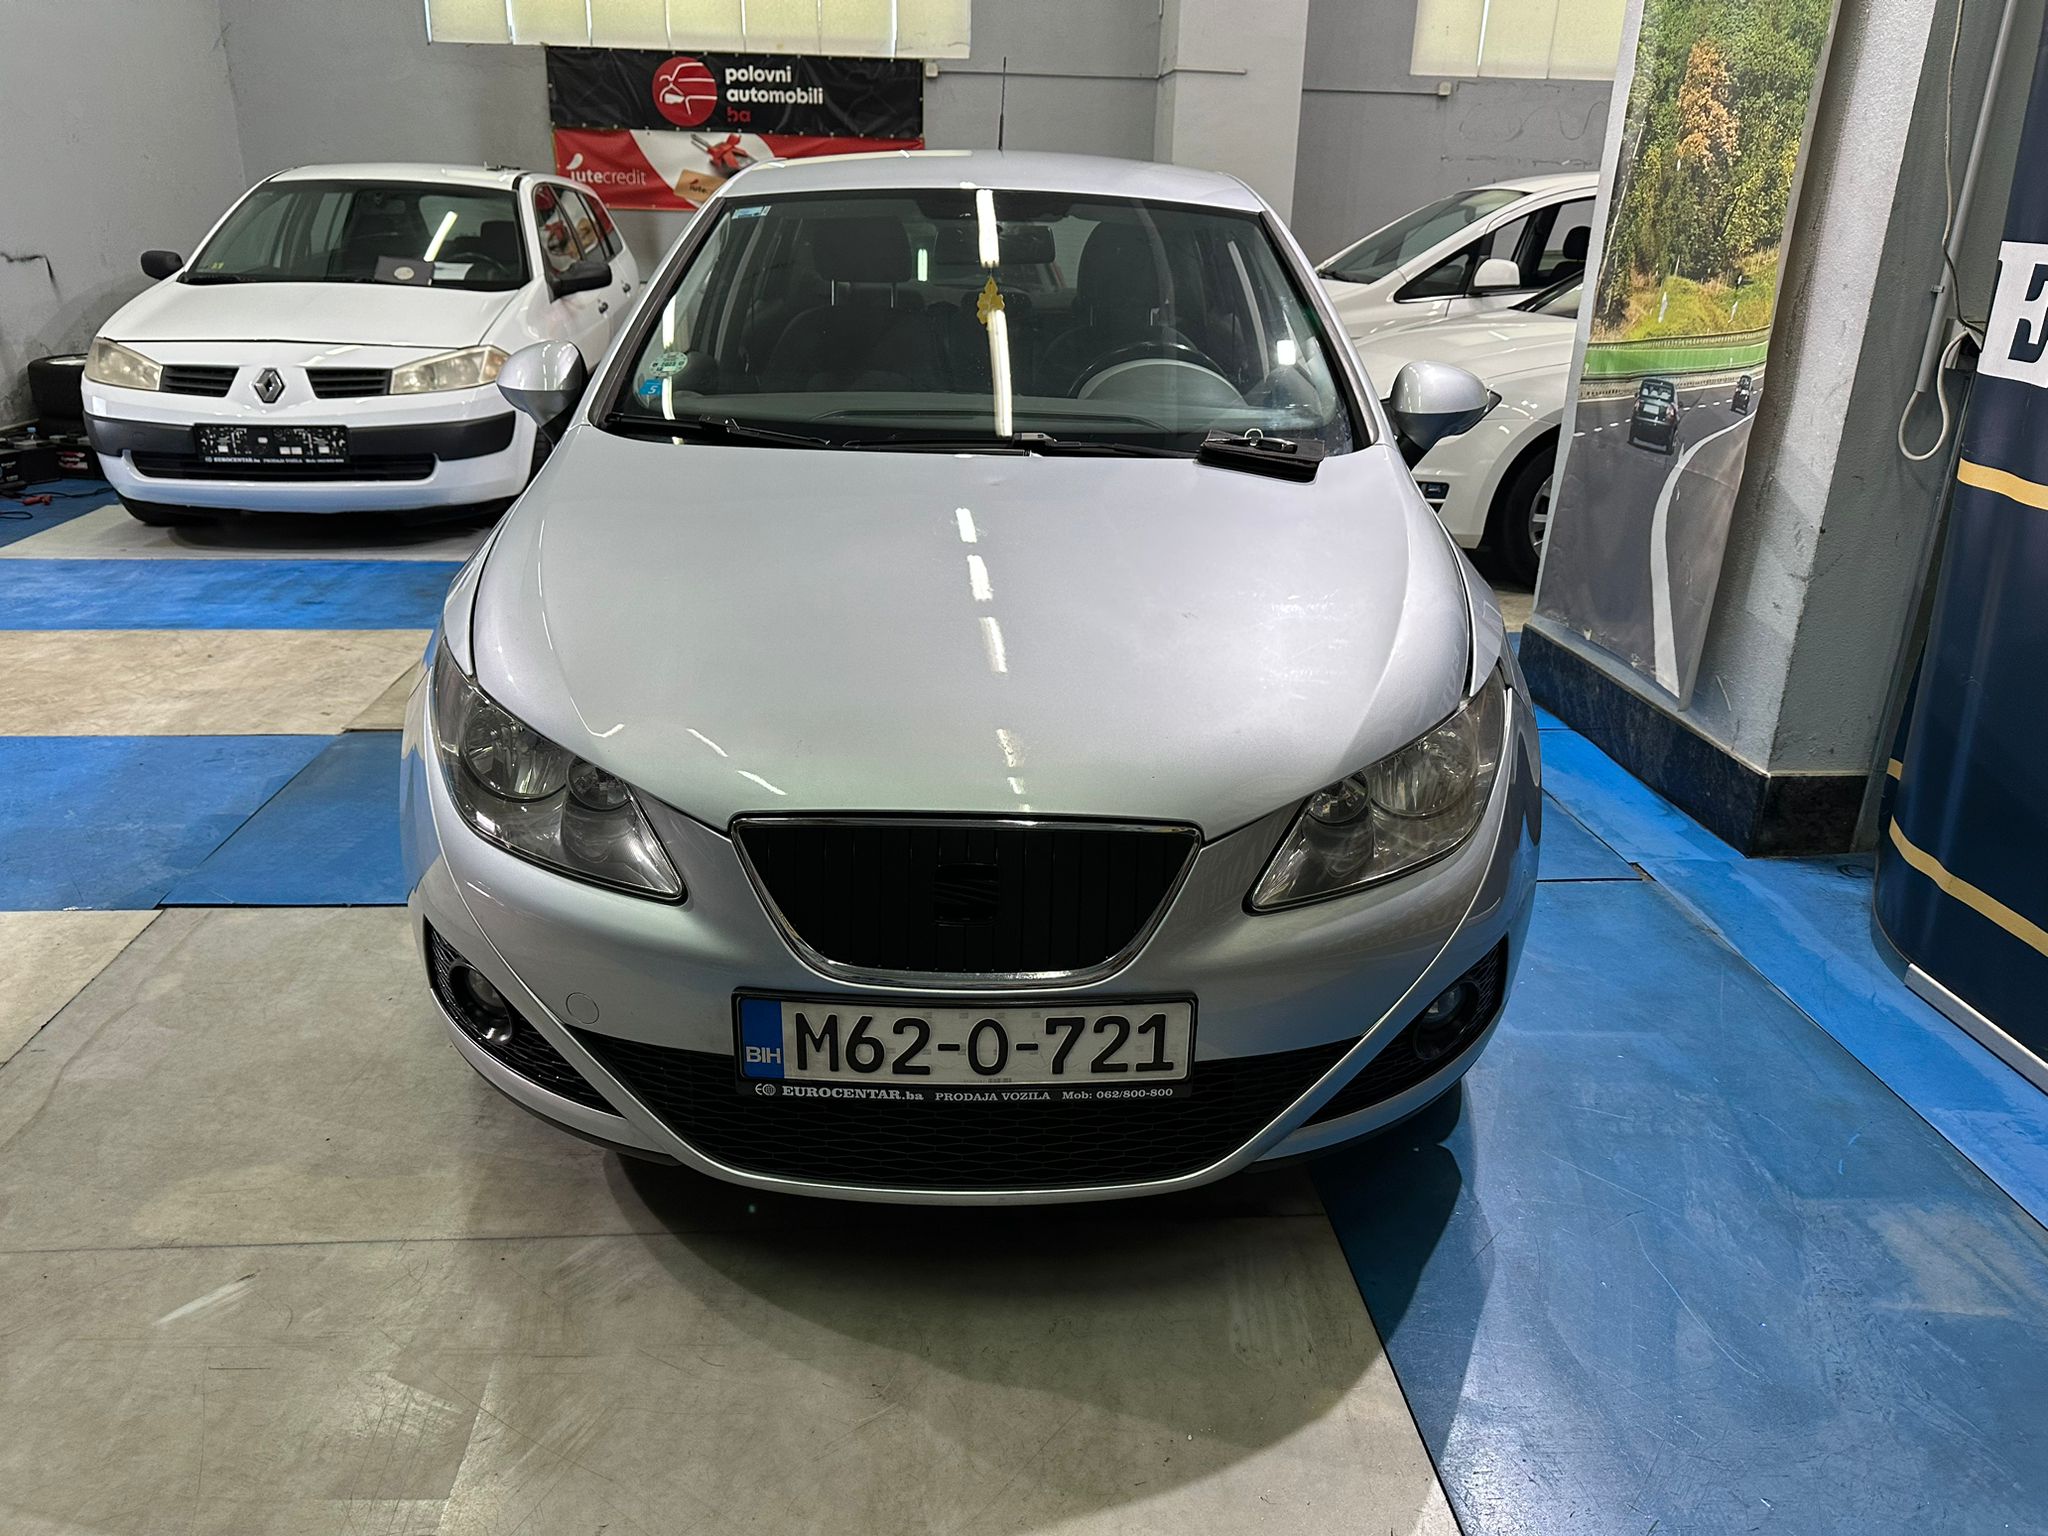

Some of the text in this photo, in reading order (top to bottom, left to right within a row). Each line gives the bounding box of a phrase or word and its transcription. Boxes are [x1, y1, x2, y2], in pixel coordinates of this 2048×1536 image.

[725, 65, 792, 84] polovni
[726, 87, 824, 104] automobili
[746, 1045, 781, 1063] BIH
[782, 1085, 1173, 1101] EUROCENTAR.ba PRODAJA VOZILA Mob: 062/800-800
